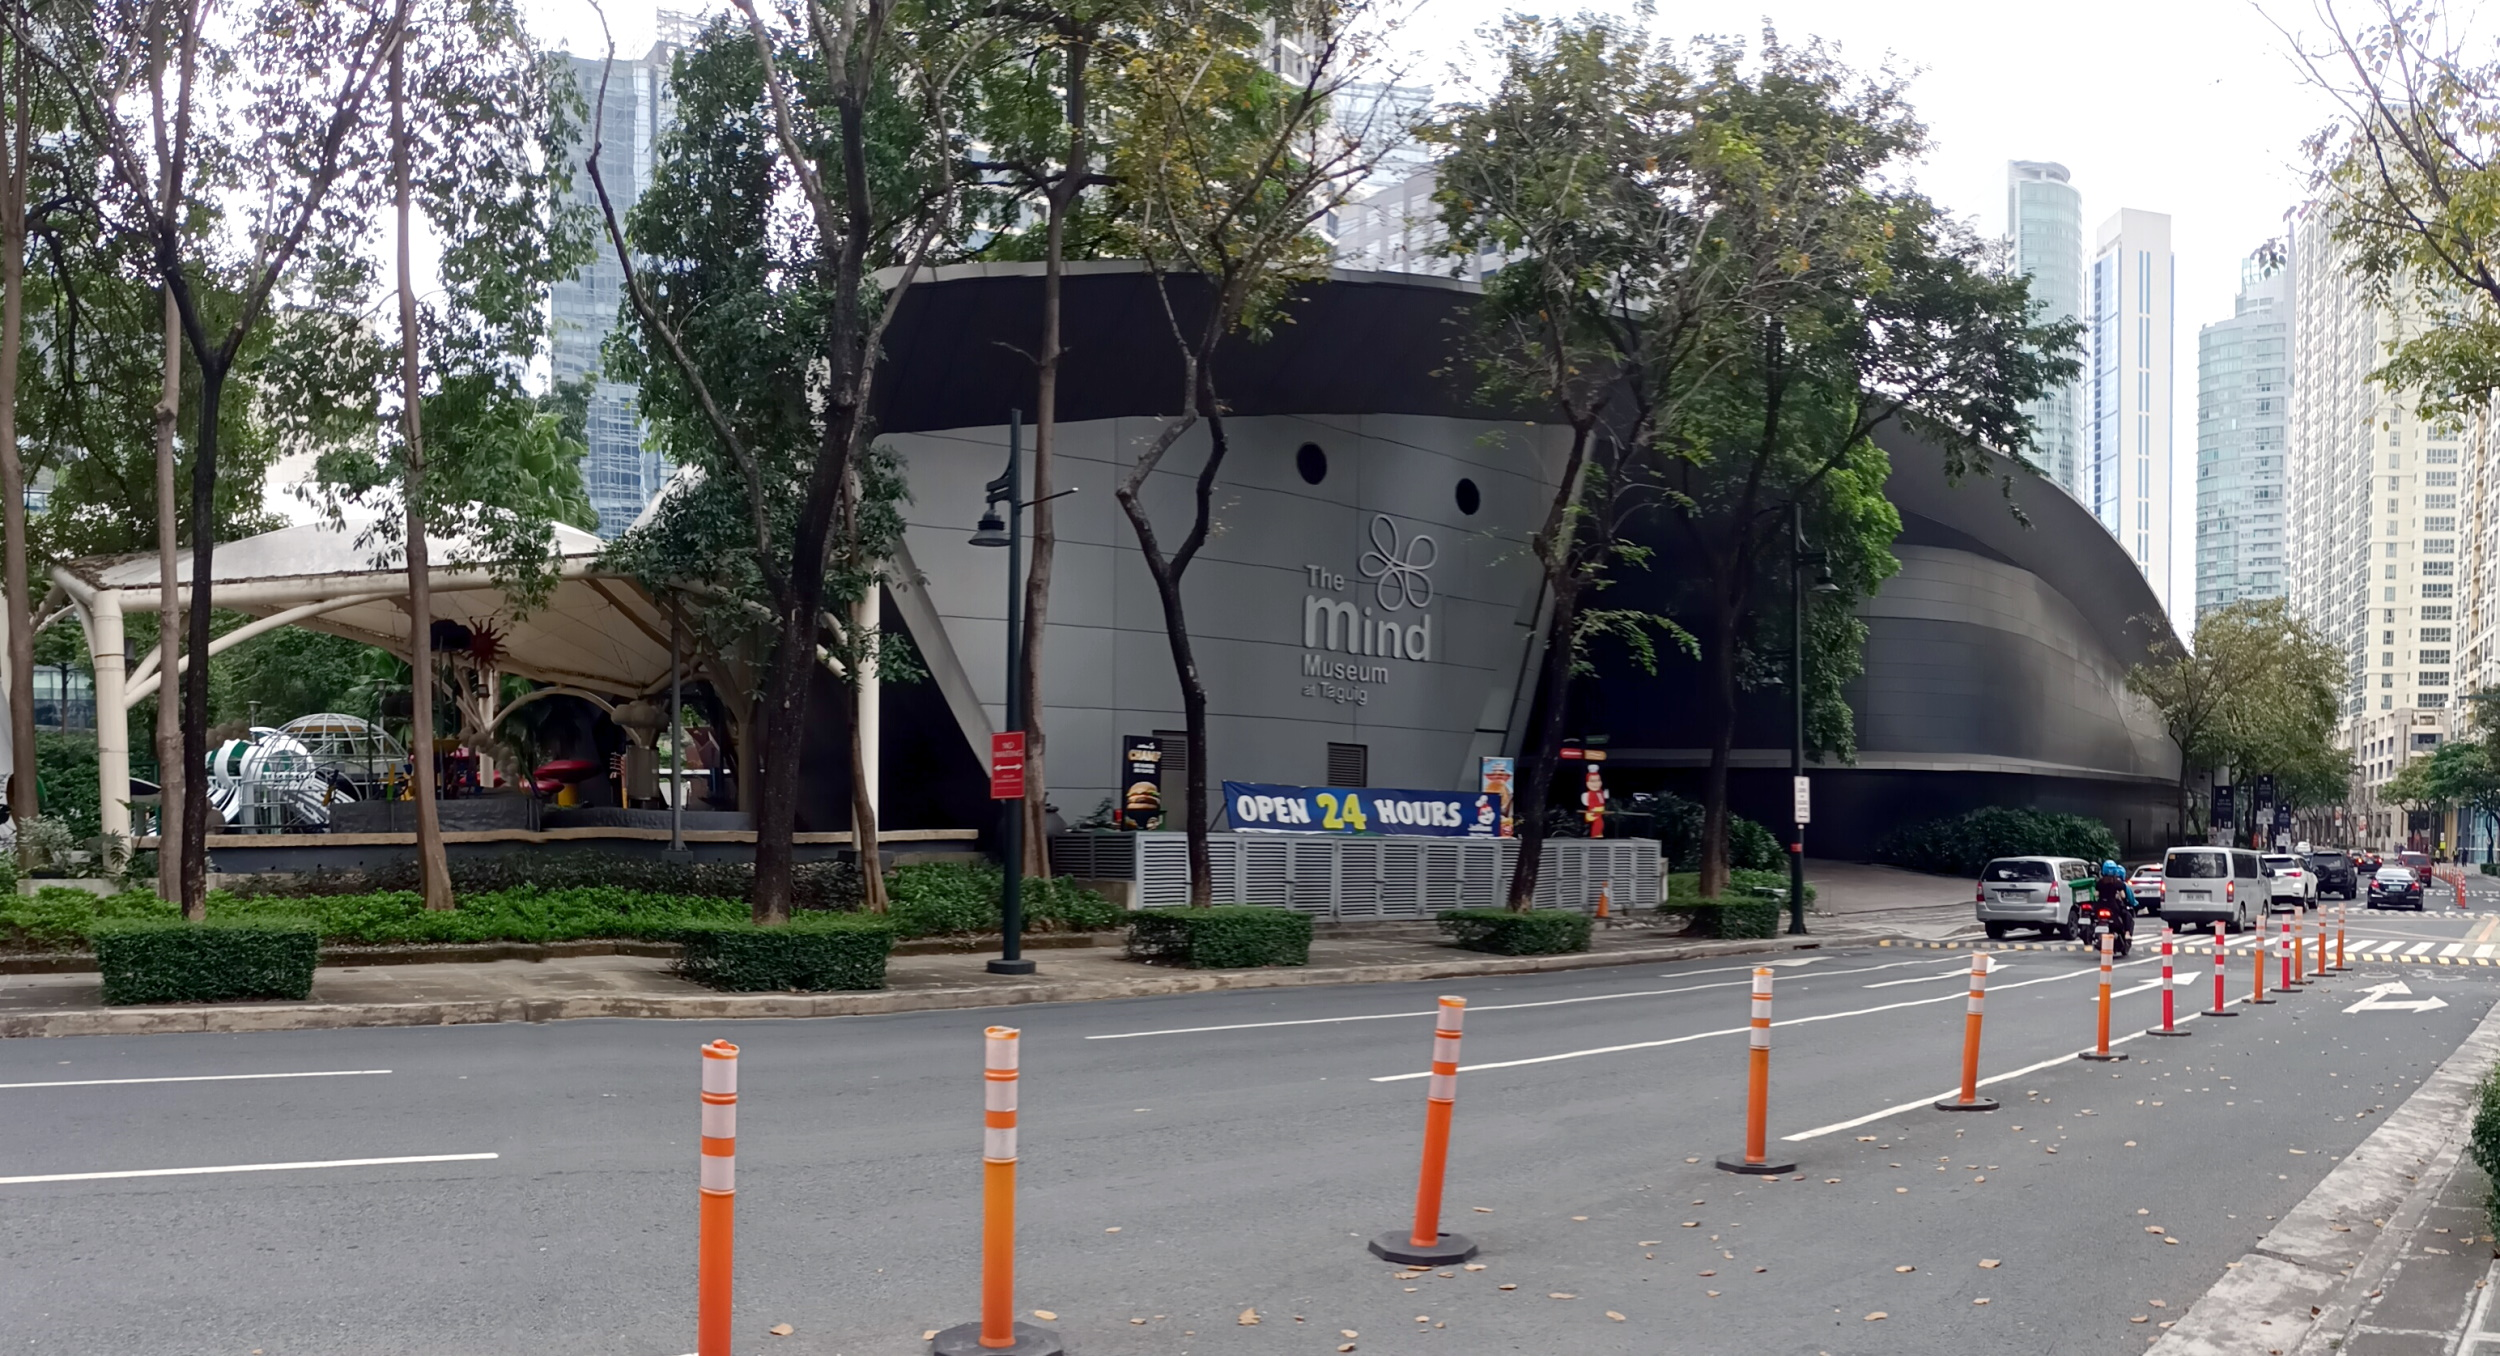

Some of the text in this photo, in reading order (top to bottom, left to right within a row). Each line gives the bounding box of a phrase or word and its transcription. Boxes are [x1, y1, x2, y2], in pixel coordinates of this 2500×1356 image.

[1304, 564, 1345, 591] The
[1304, 594, 1431, 661] mind
[1303, 653, 1389, 683] Museum
[1303, 681, 1368, 705] at Taguig
[1236, 792, 1462, 830] OPEN 24 HOURS
